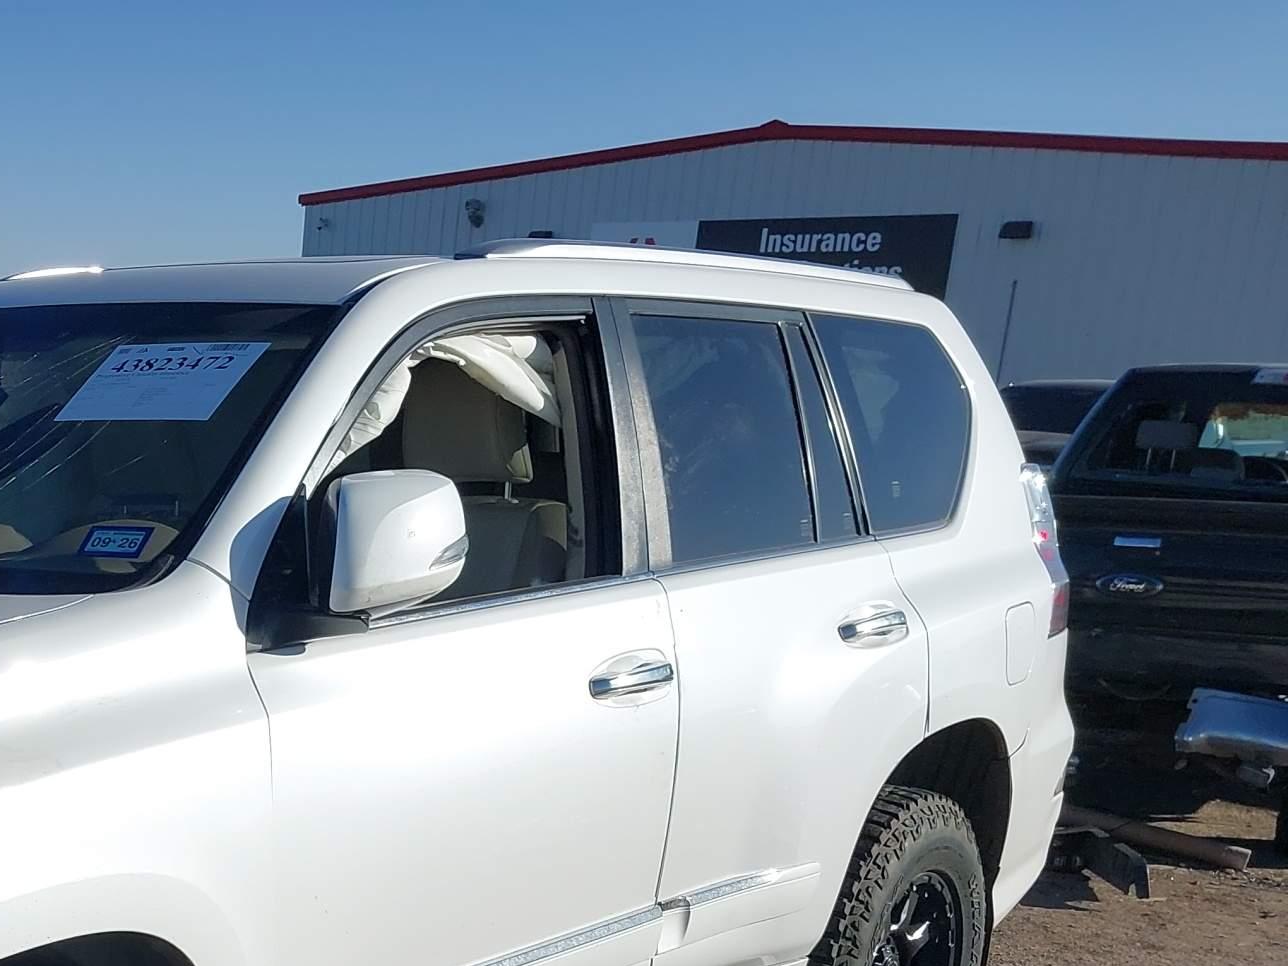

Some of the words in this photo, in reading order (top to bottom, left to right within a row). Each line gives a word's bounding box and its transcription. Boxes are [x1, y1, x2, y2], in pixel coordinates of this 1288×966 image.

[759, 227, 882, 253] Insurance
[111, 355, 235, 373] 43823472
[1109, 576, 1146, 593] Ford
